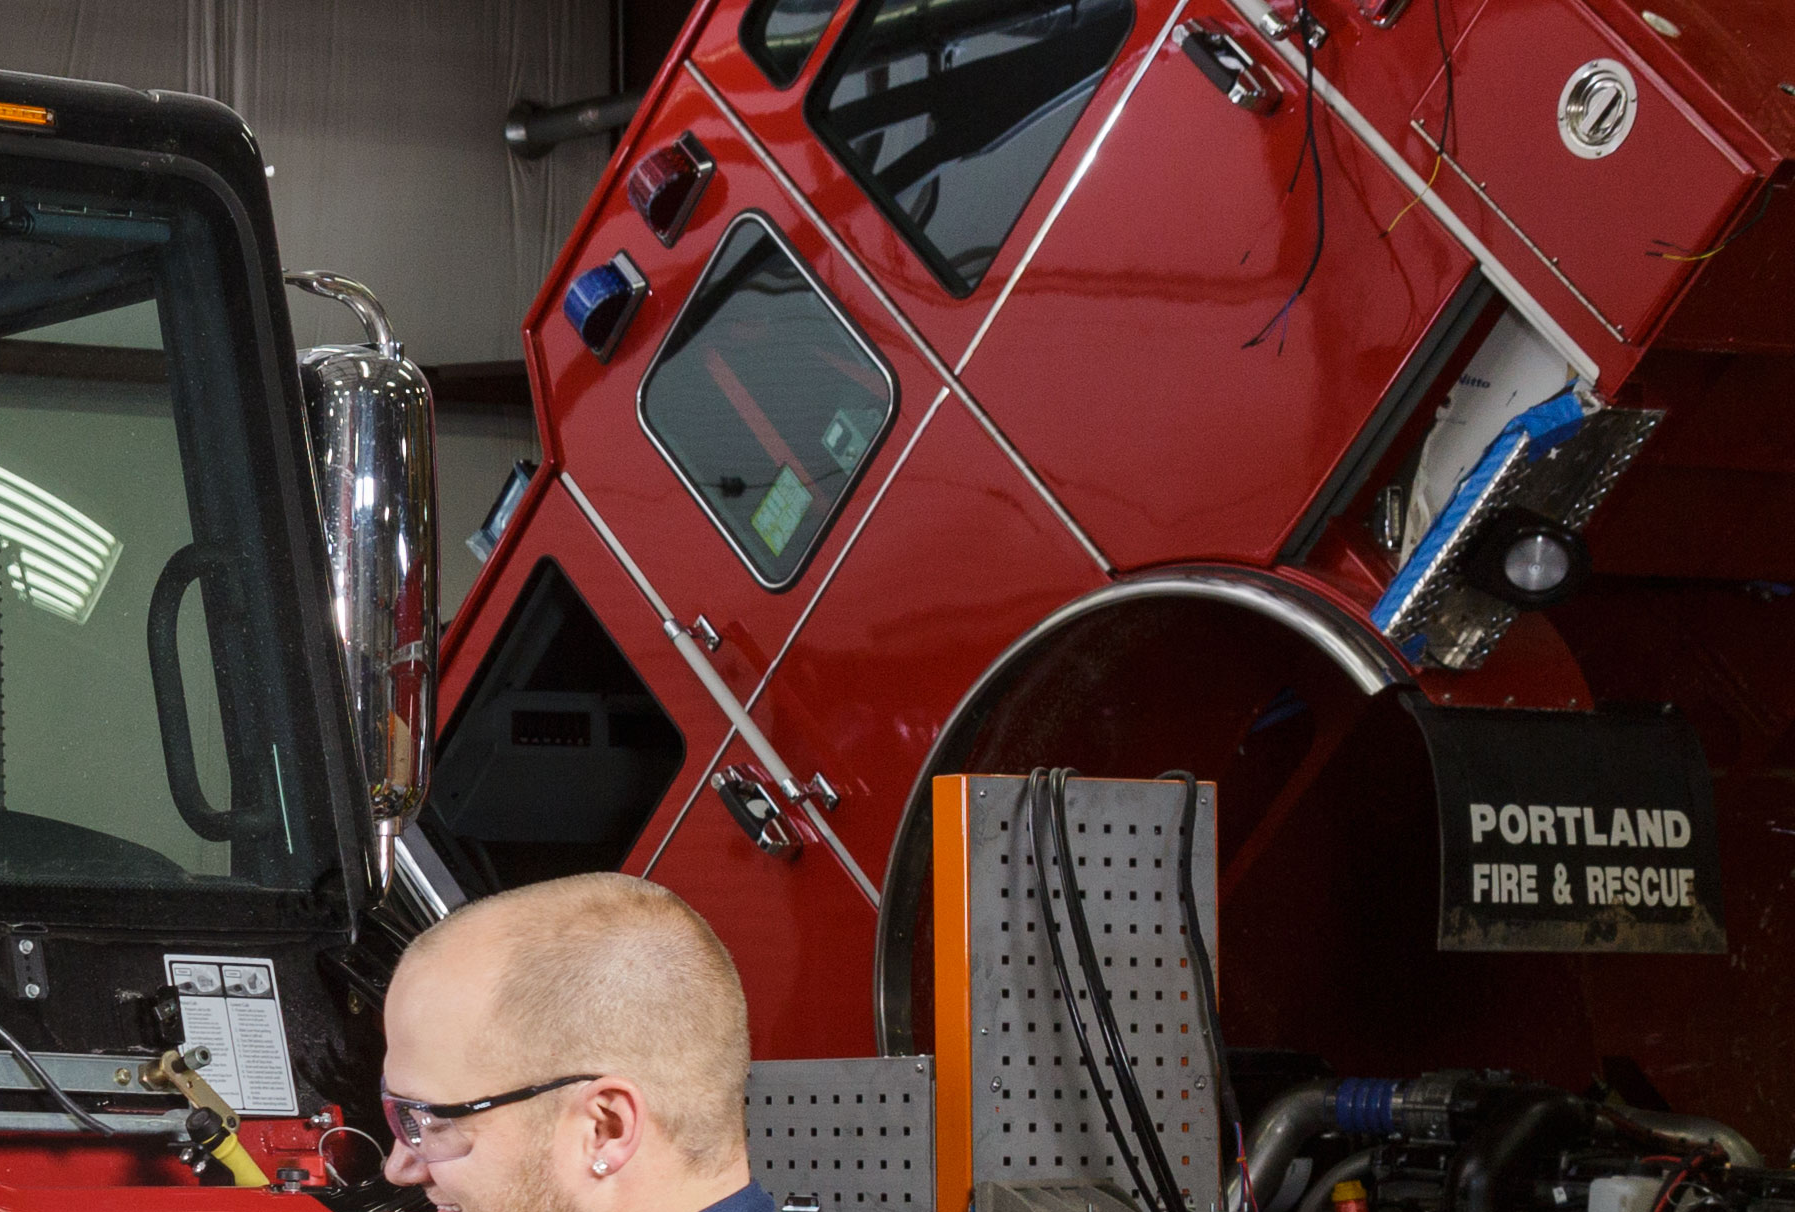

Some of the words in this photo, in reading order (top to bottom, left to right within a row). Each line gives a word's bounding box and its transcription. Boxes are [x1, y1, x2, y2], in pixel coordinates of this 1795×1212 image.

[1470, 803, 1691, 848] PORTLAND
[1472, 863, 1539, 904] FIRE
[1552, 862, 1573, 905] &
[1586, 865, 1695, 908] RESCUE
